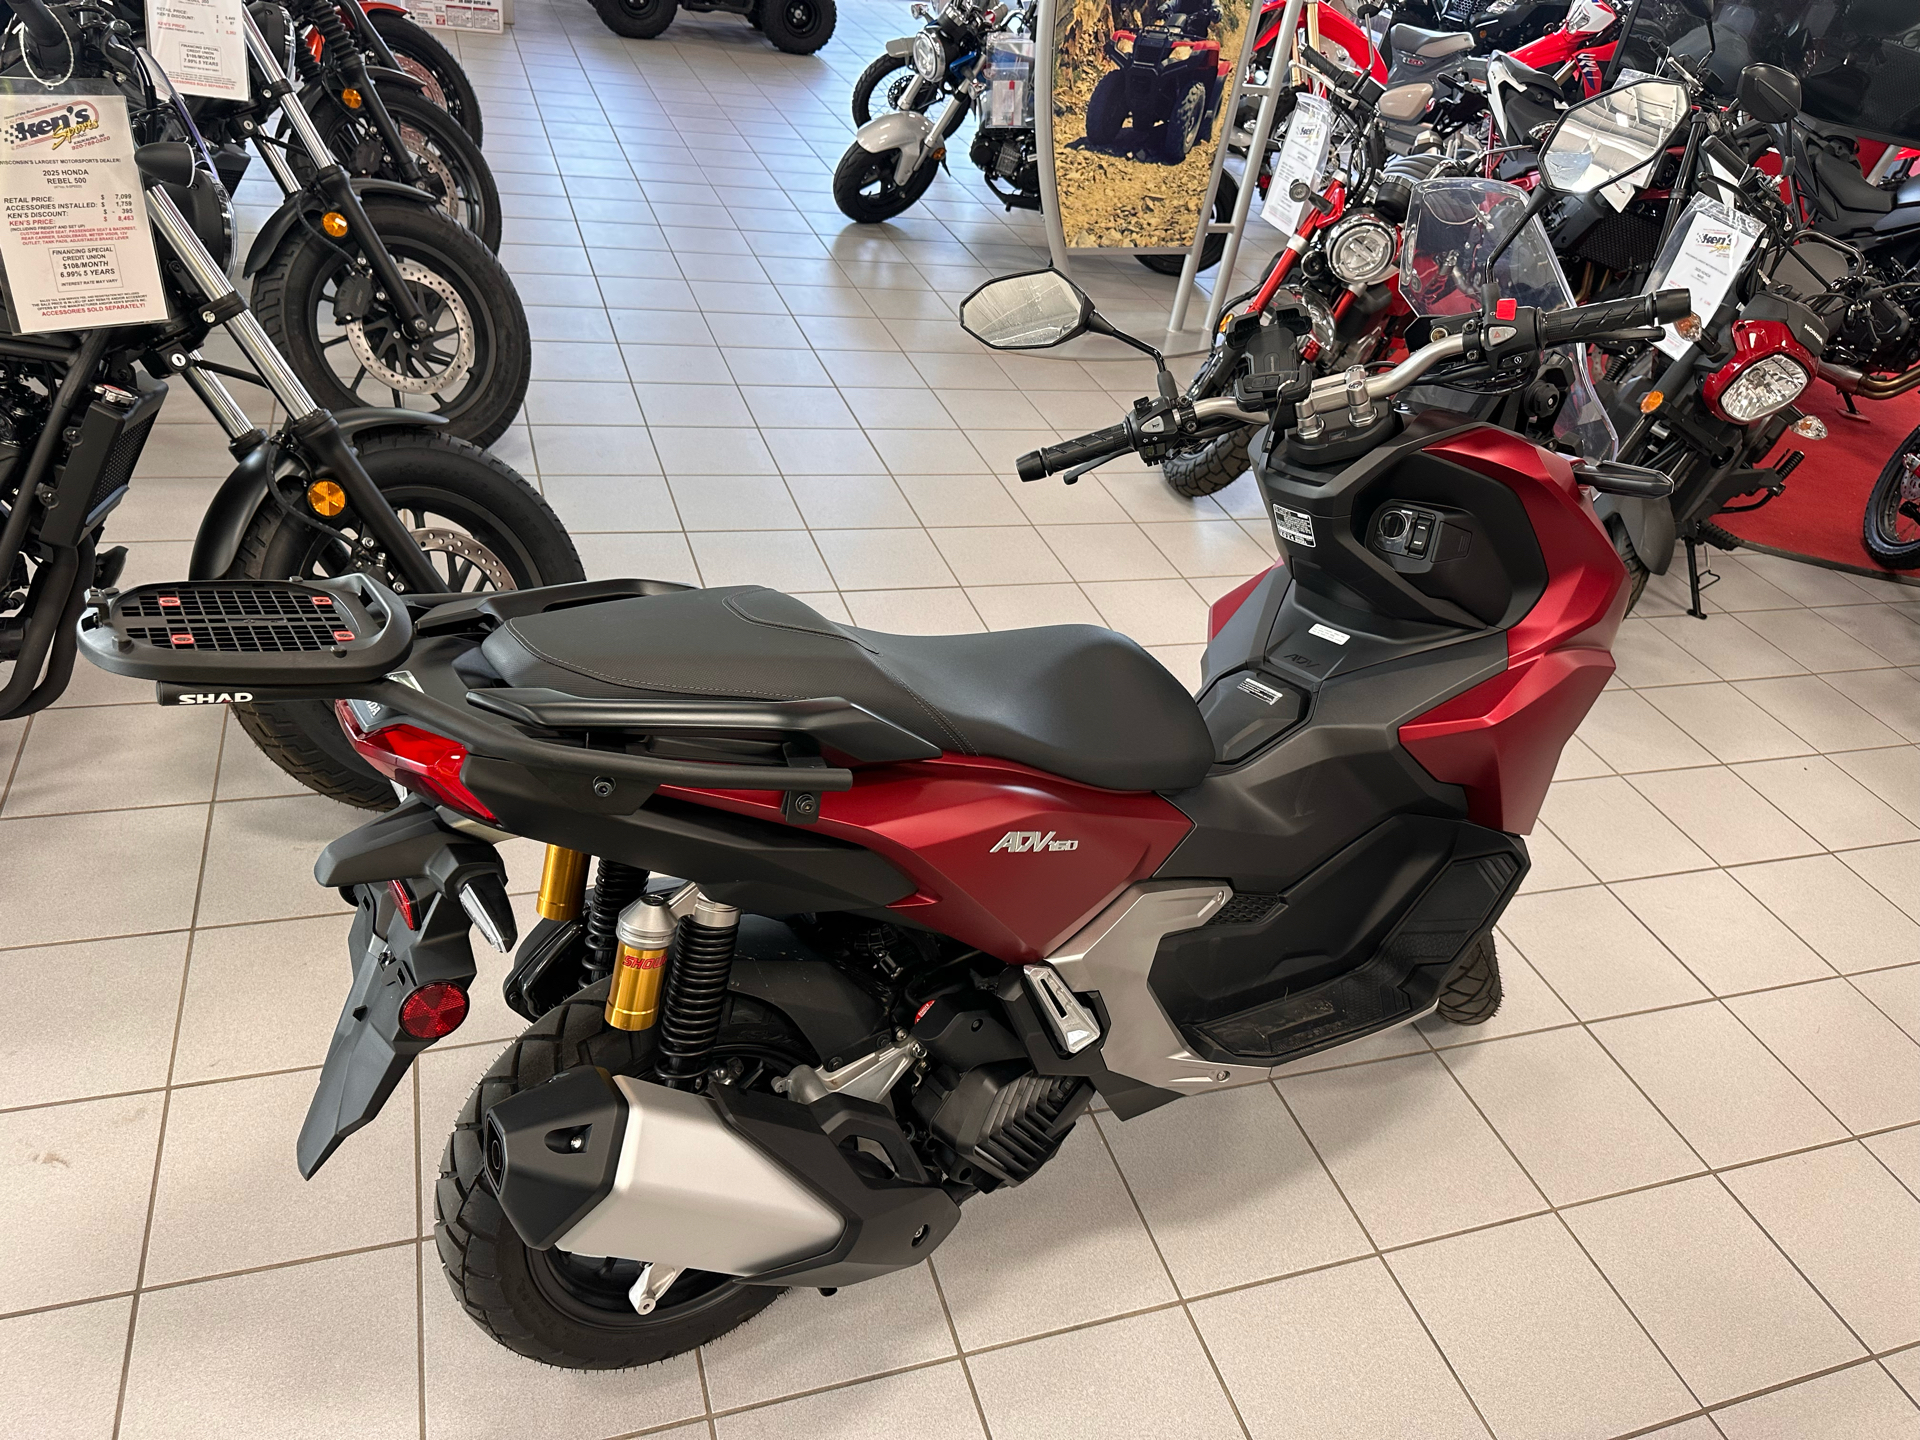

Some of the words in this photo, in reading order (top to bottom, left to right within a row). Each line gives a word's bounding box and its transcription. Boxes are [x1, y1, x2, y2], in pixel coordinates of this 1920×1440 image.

[15, 106, 90, 142] ken's
[52, 119, 99, 150] Sports
[42, 307, 86, 316] ACCESSORIES
[1804, 324, 1824, 345] HONDA
[1283, 653, 1320, 668] ADV
[178, 692, 253, 704] SHAD
